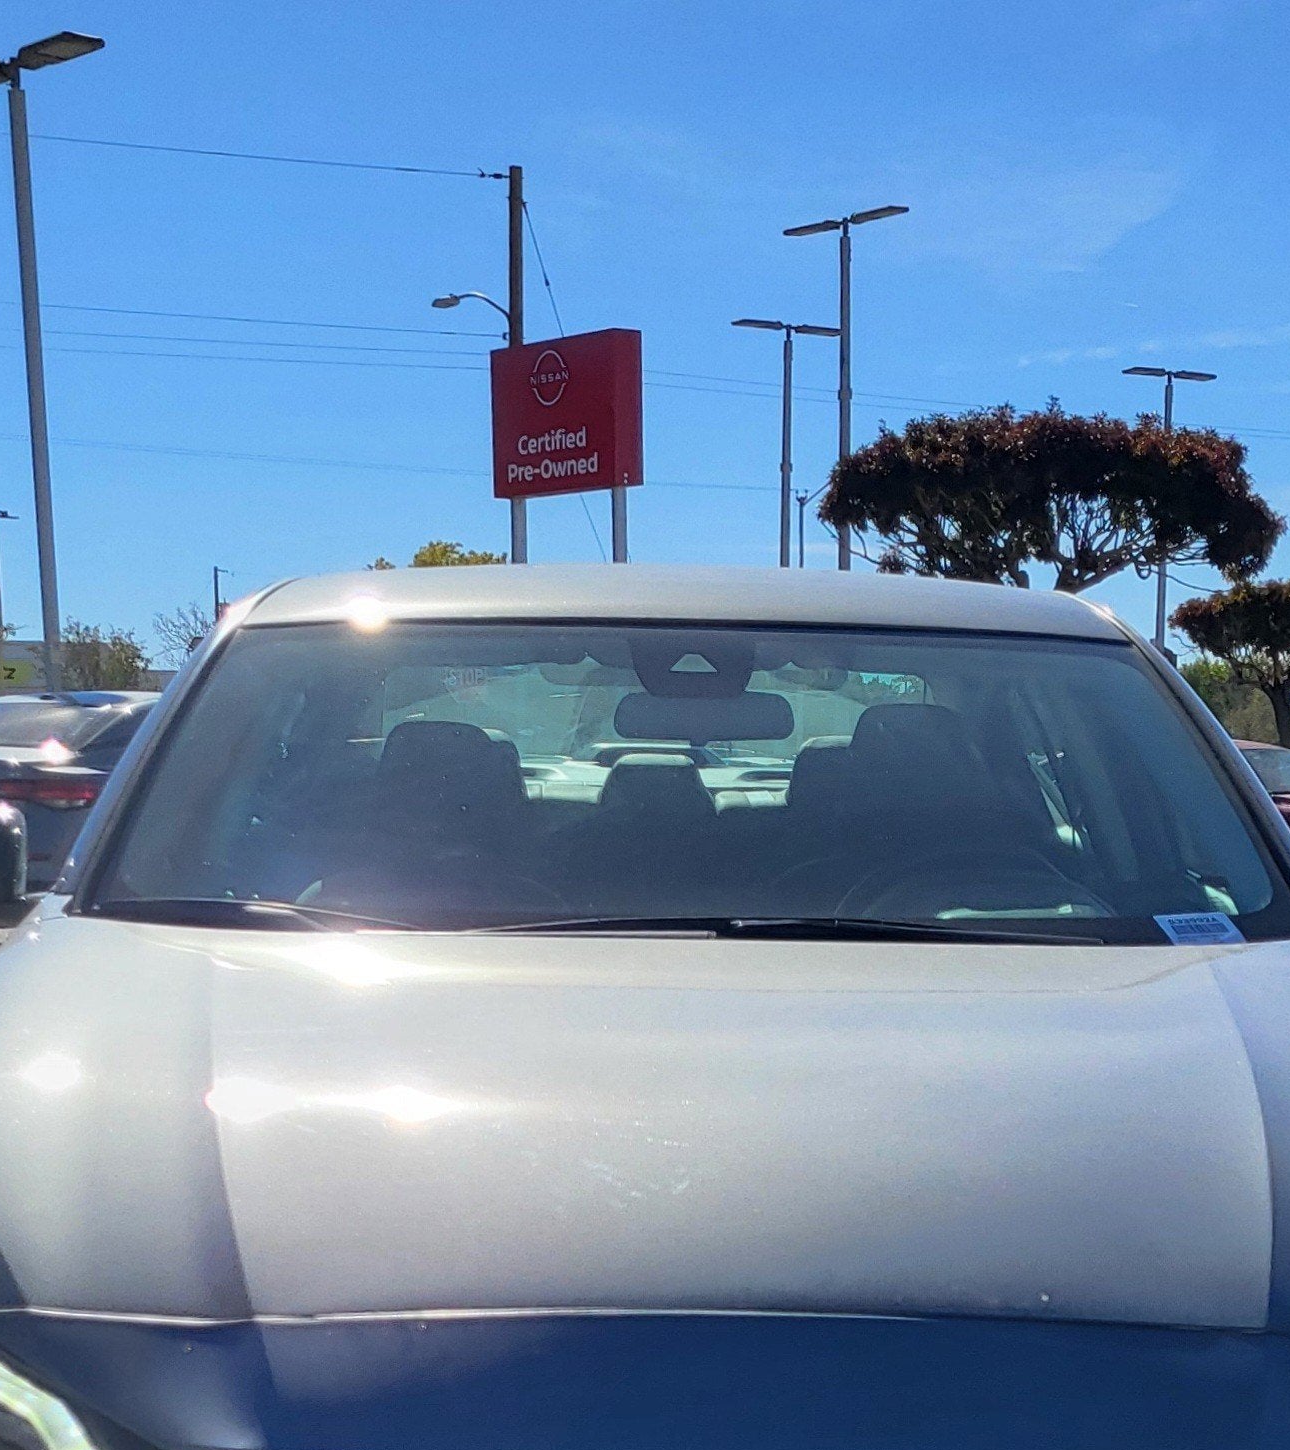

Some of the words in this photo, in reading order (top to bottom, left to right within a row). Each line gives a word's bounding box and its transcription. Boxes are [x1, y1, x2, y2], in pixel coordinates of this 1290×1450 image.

[529, 370, 570, 385] NISSAN
[517, 426, 587, 456] Certified
[507, 452, 599, 484] Pre-Owned
